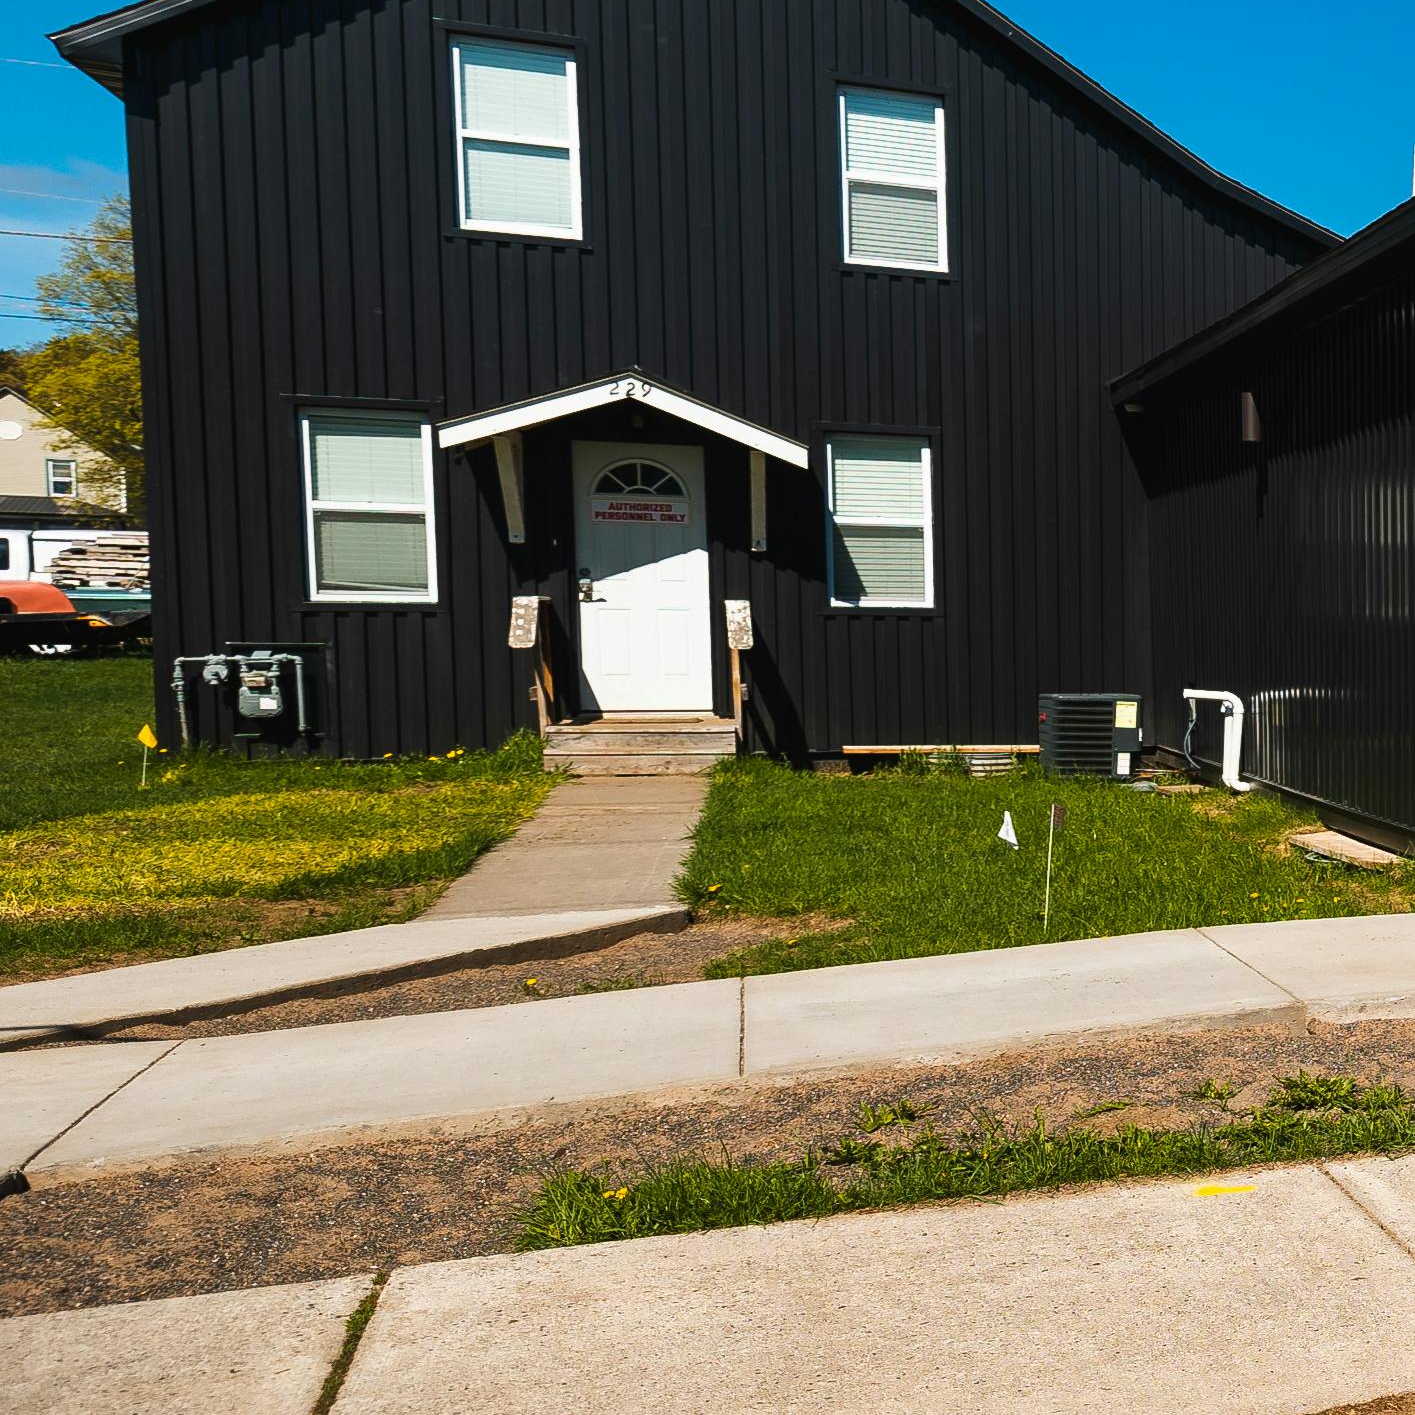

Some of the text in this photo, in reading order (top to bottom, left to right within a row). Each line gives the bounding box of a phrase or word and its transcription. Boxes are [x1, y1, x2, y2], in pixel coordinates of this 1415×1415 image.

[608, 502, 672, 512] AUTHORIZED
[595, 512, 686, 522] PERSONNEL ONLY
